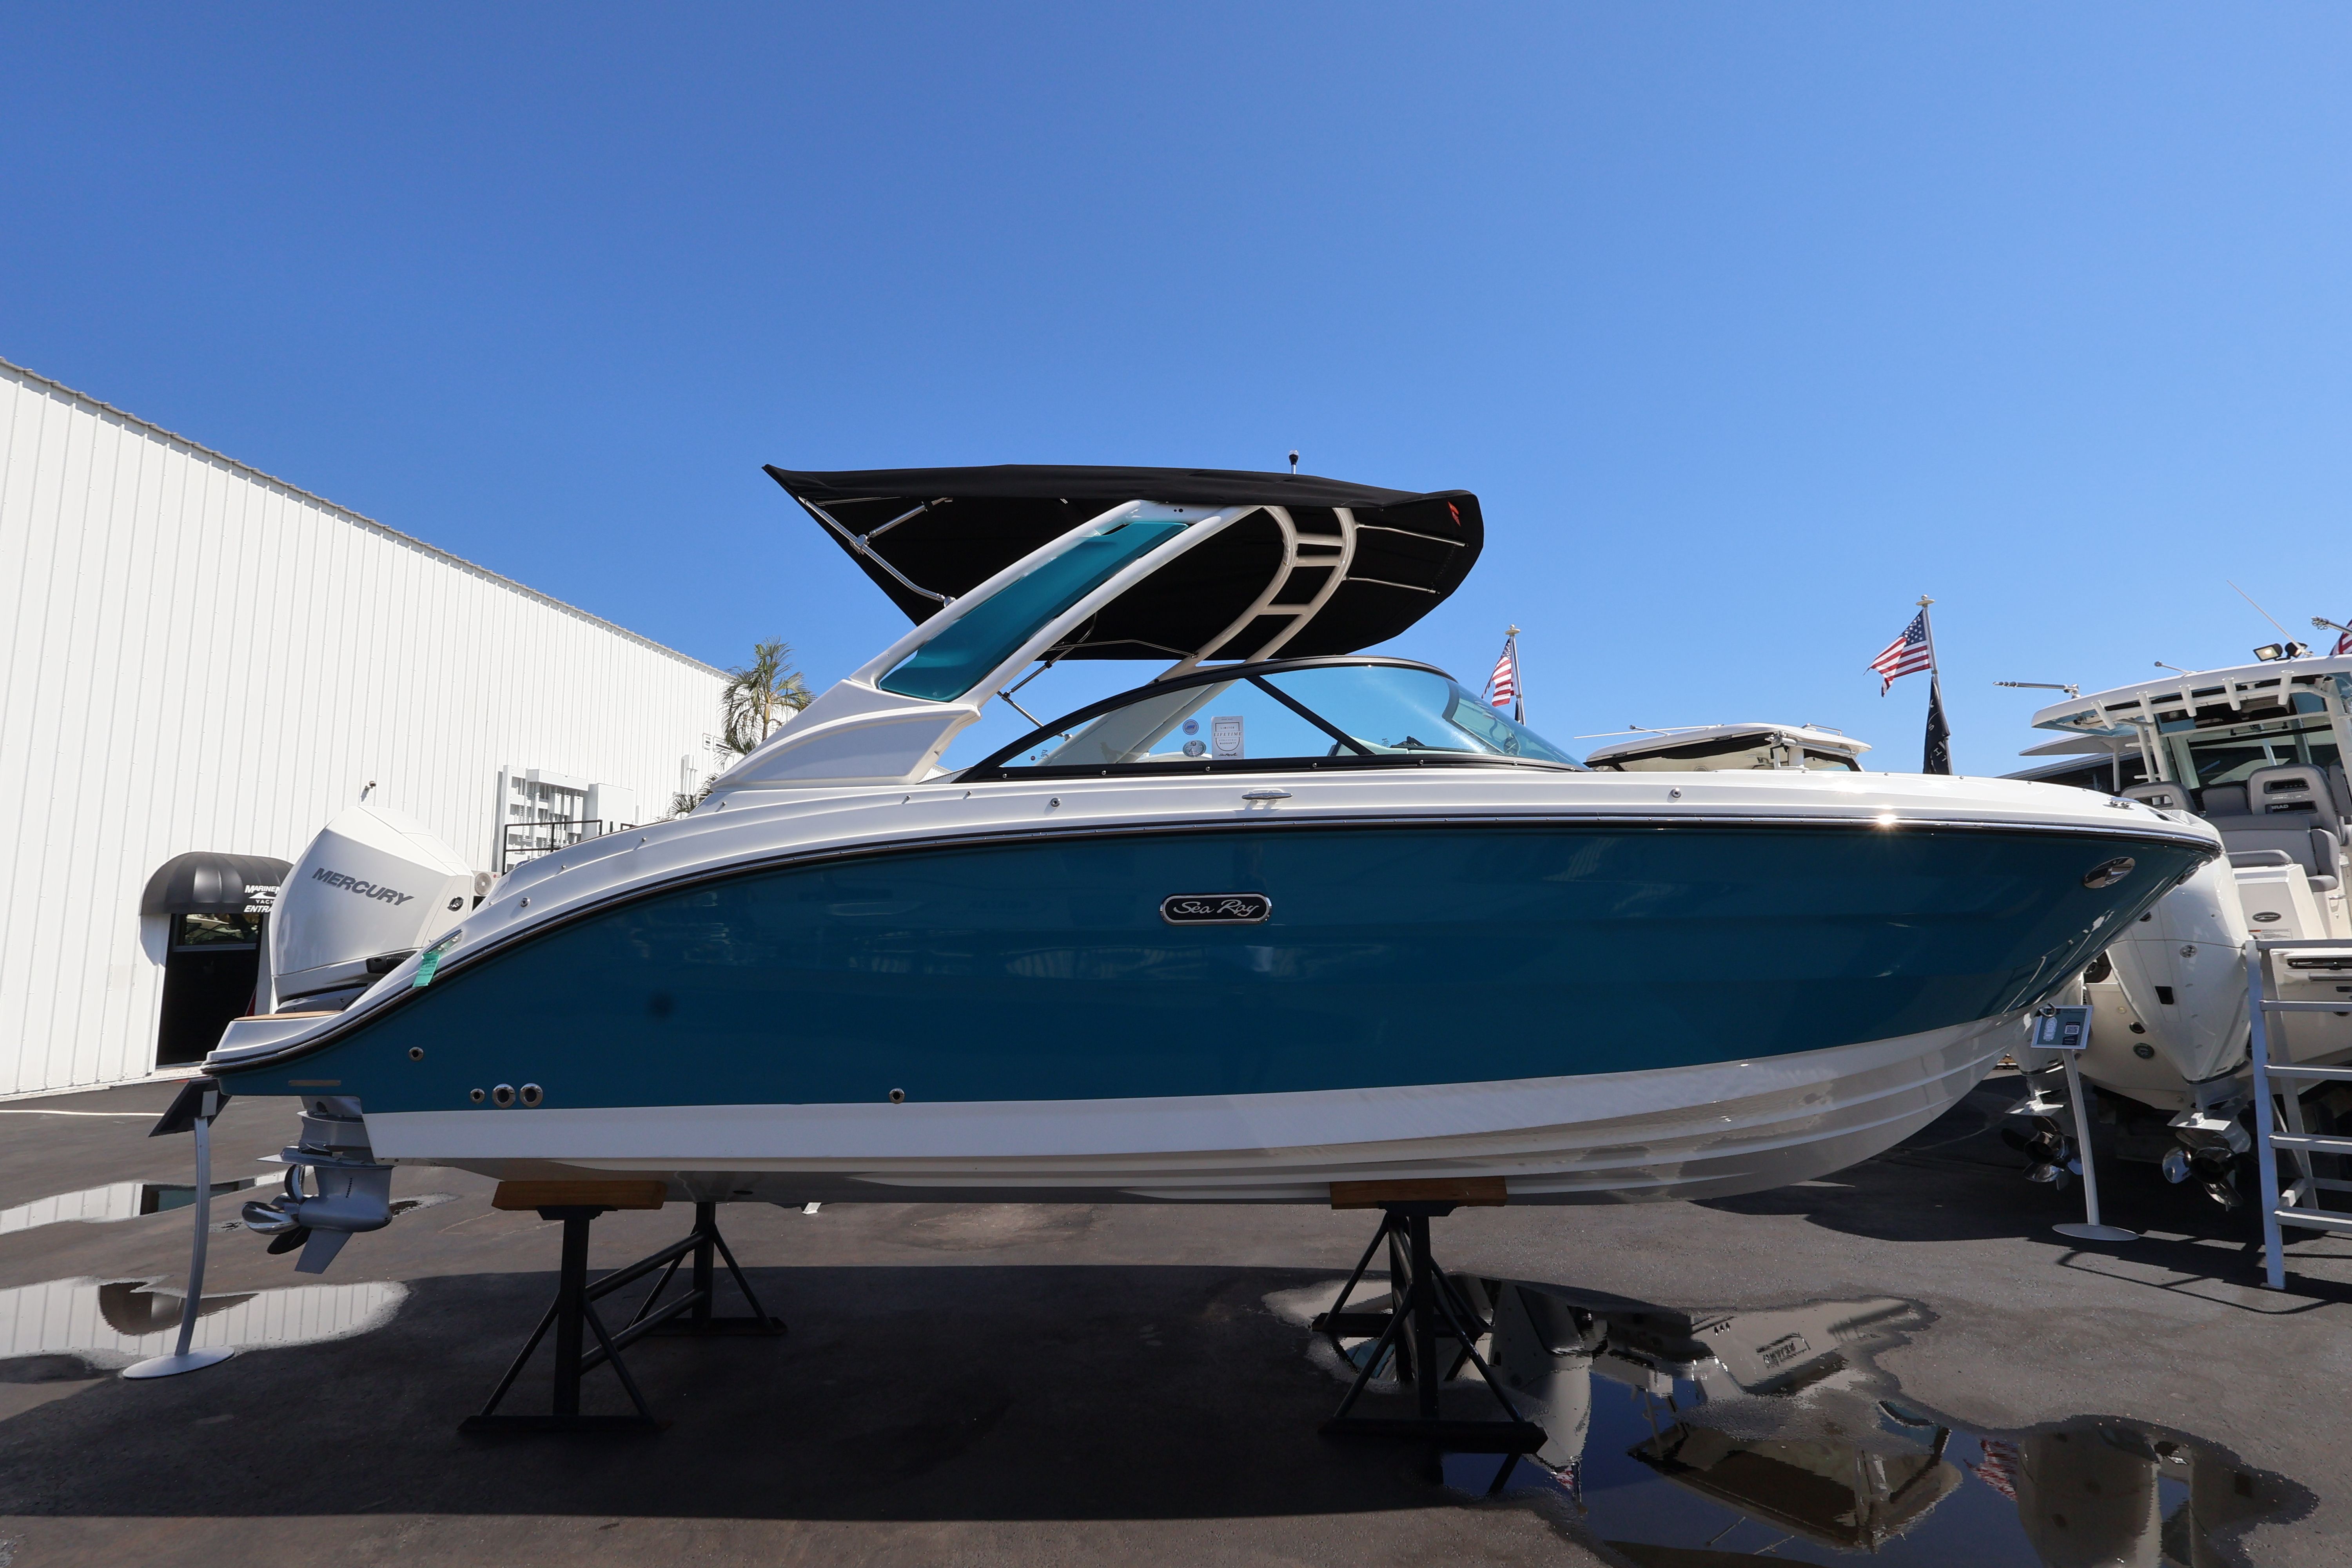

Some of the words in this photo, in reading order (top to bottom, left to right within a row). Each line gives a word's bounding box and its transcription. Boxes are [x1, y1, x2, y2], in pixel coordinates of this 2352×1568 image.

[312, 868, 415, 906] MERCURY
[1173, 902, 1214, 914] Sea
[1217, 899, 1259, 917] Ray
